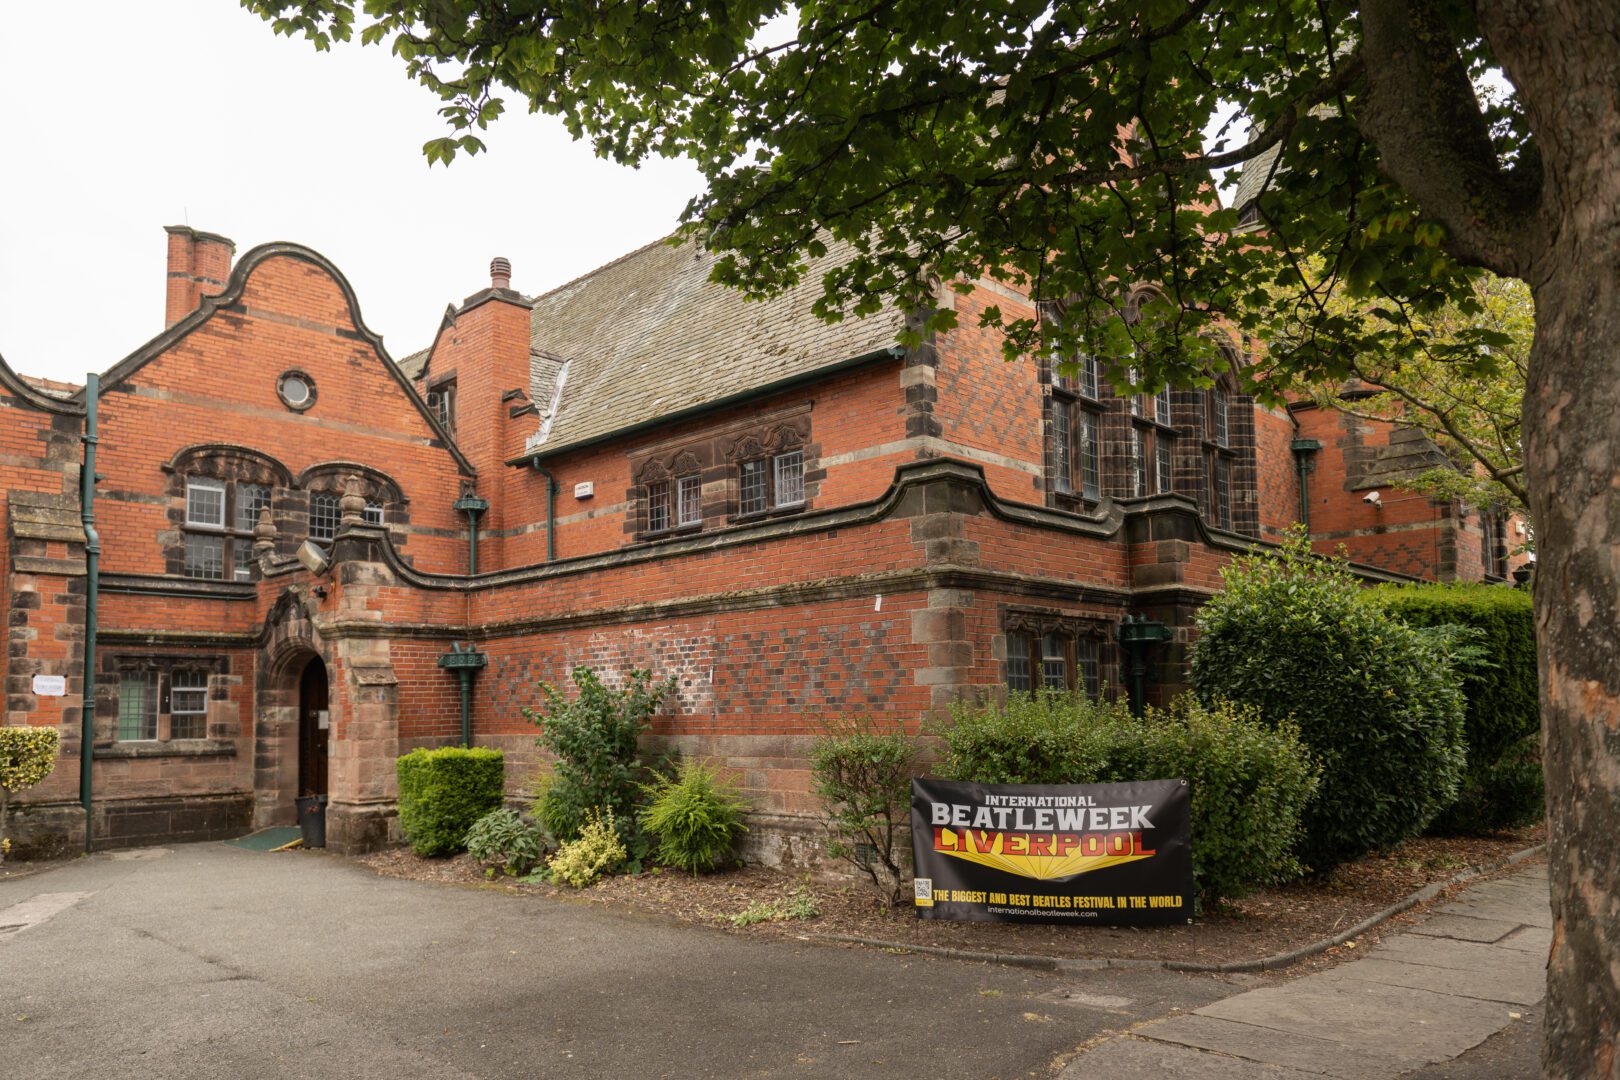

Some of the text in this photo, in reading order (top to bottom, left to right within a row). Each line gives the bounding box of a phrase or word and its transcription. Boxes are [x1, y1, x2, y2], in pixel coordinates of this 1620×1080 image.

[985, 795, 1096, 807] INTERNATIONAL
[931, 802, 1156, 831] BEATLEWEEK
[933, 827, 1156, 857] LIVERPOOL
[933, 889, 1183, 908] THE BIGGEST AND BEST BEATLES FESTIVAL IN THE WORLD
[987, 906, 1098, 917] internationalbeatleweek.com
